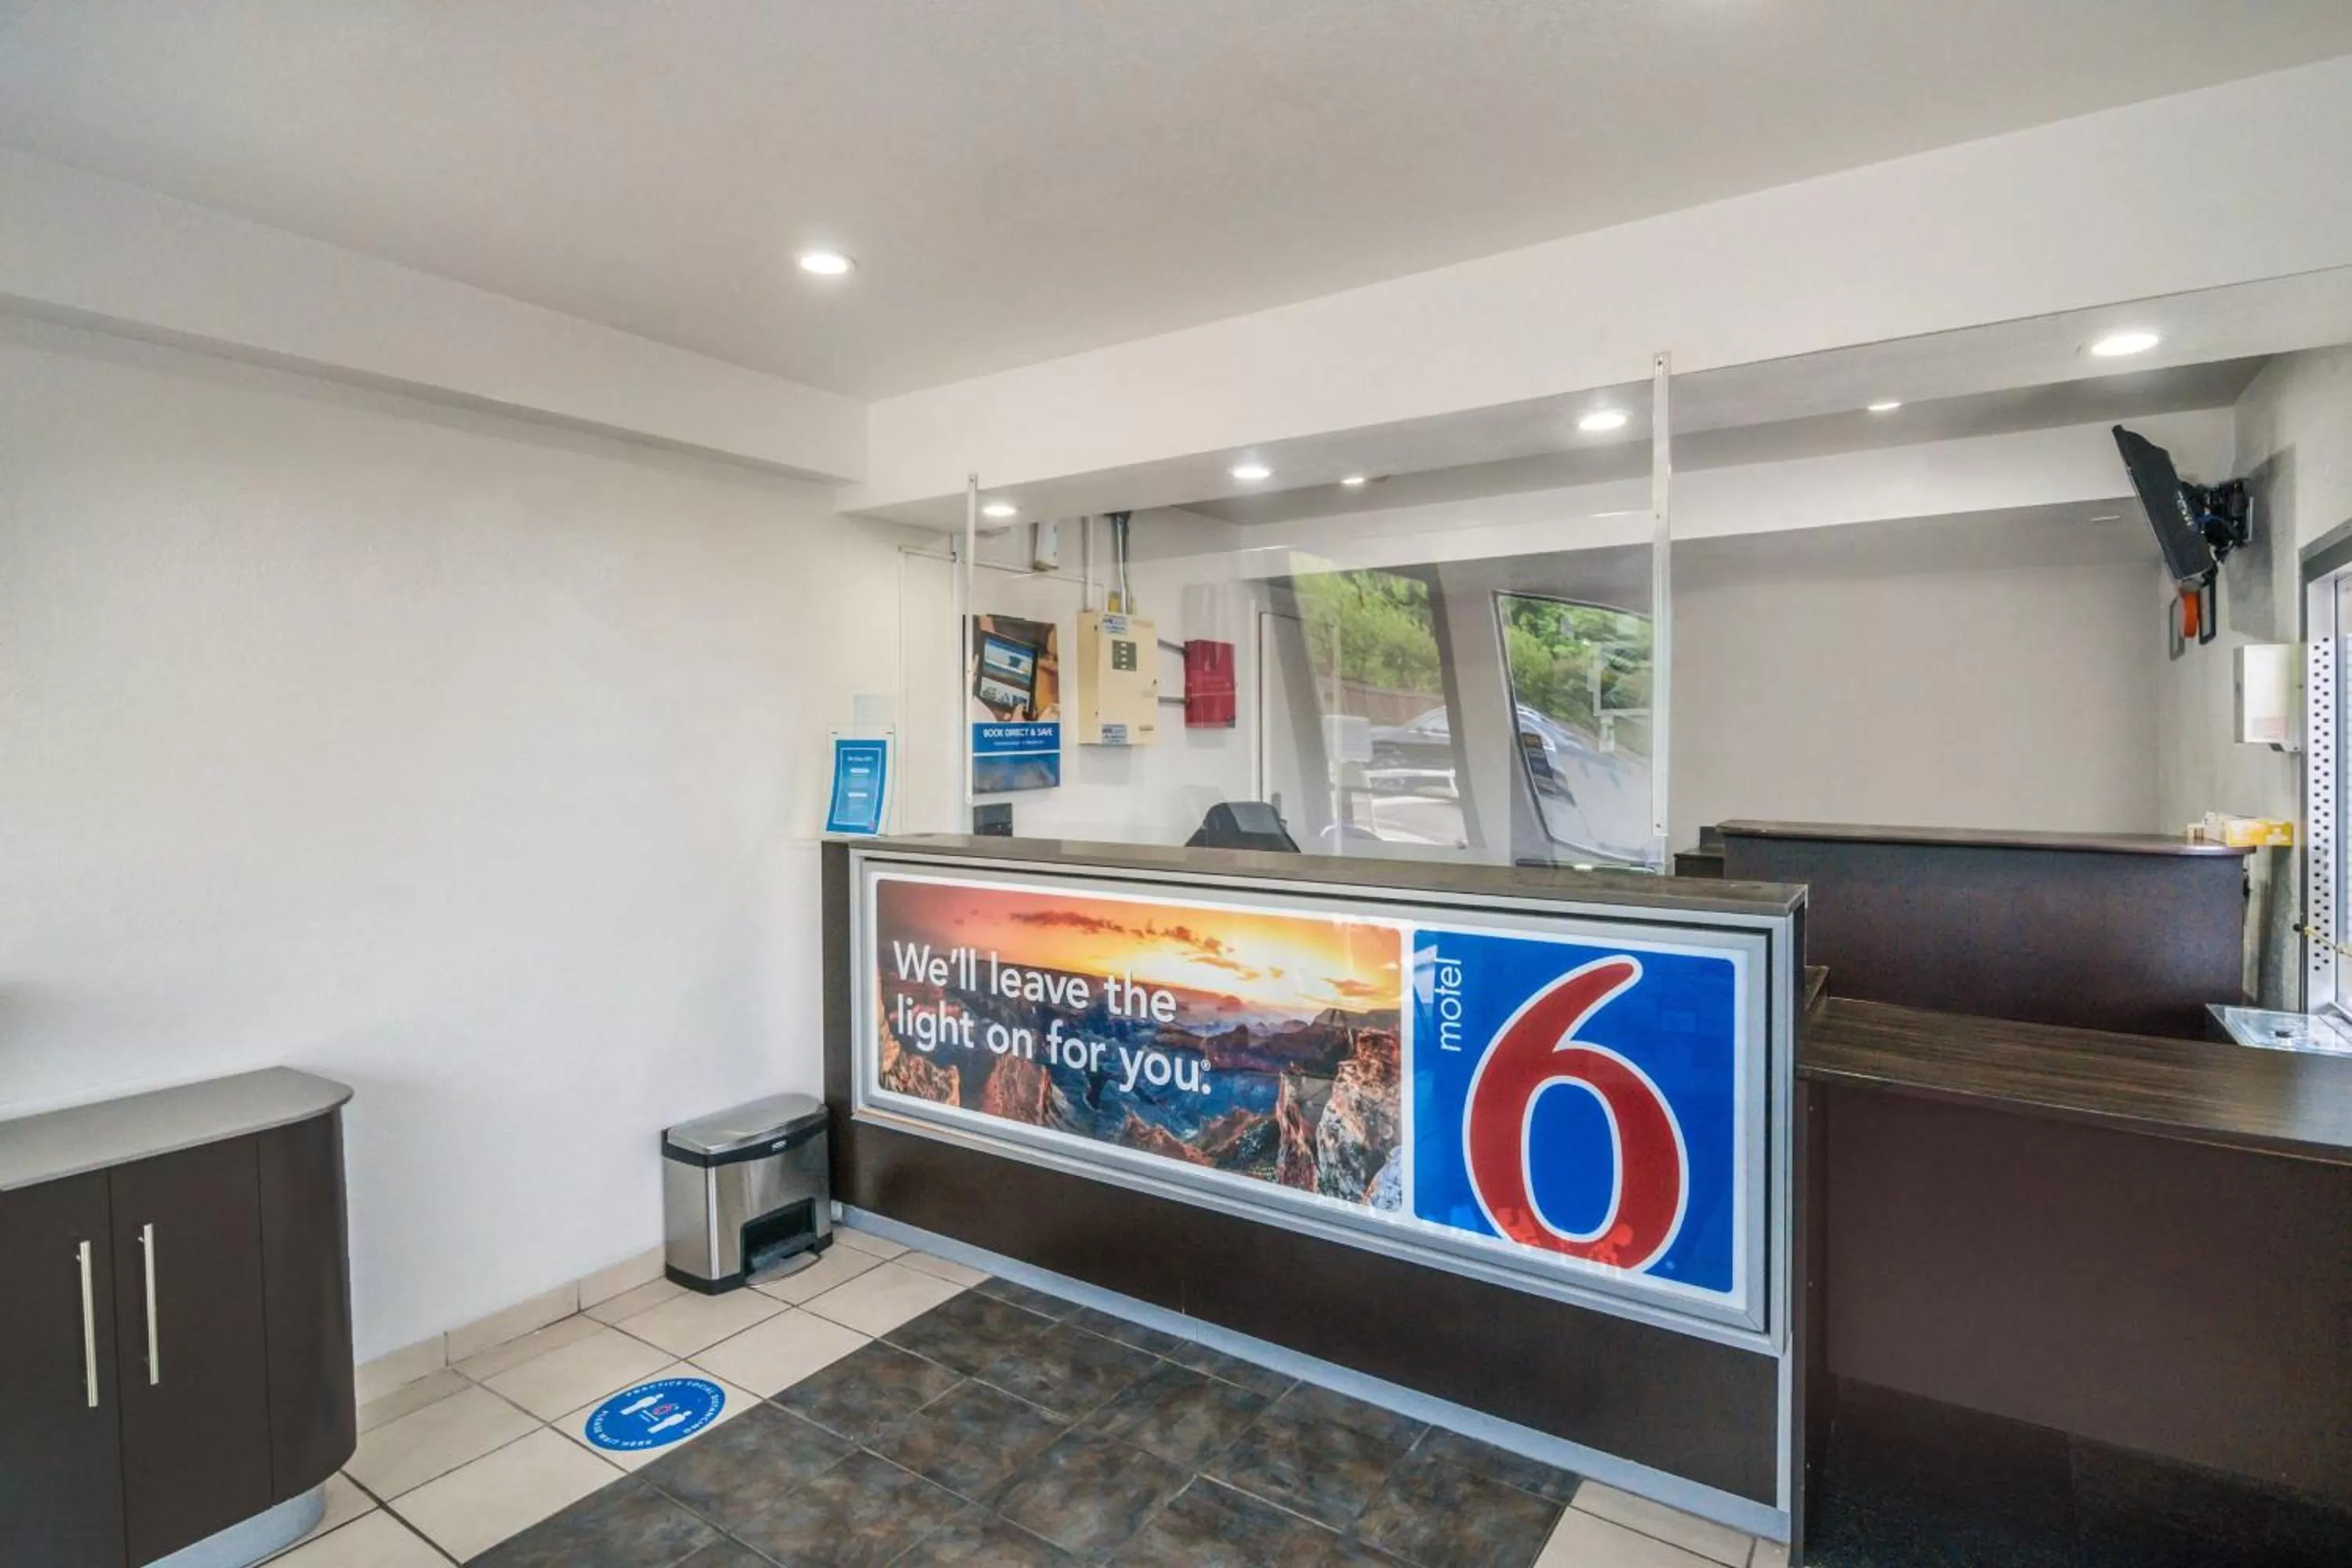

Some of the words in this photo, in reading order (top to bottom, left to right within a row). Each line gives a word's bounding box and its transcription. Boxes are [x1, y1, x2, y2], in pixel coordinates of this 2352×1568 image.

[983, 728, 1004, 738] BOOK
[1037, 727, 1054, 736] SAVE
[893, 940, 977, 992] We'll
[990, 951, 1091, 1010] leave
[1104, 970, 1176, 1022] the
[897, 993, 975, 1052] light
[986, 1023, 1033, 1059] on
[1047, 1019, 1106, 1072] for
[1435, 957, 1462, 1052] motel
[1462, 954, 1690, 1274] 6
